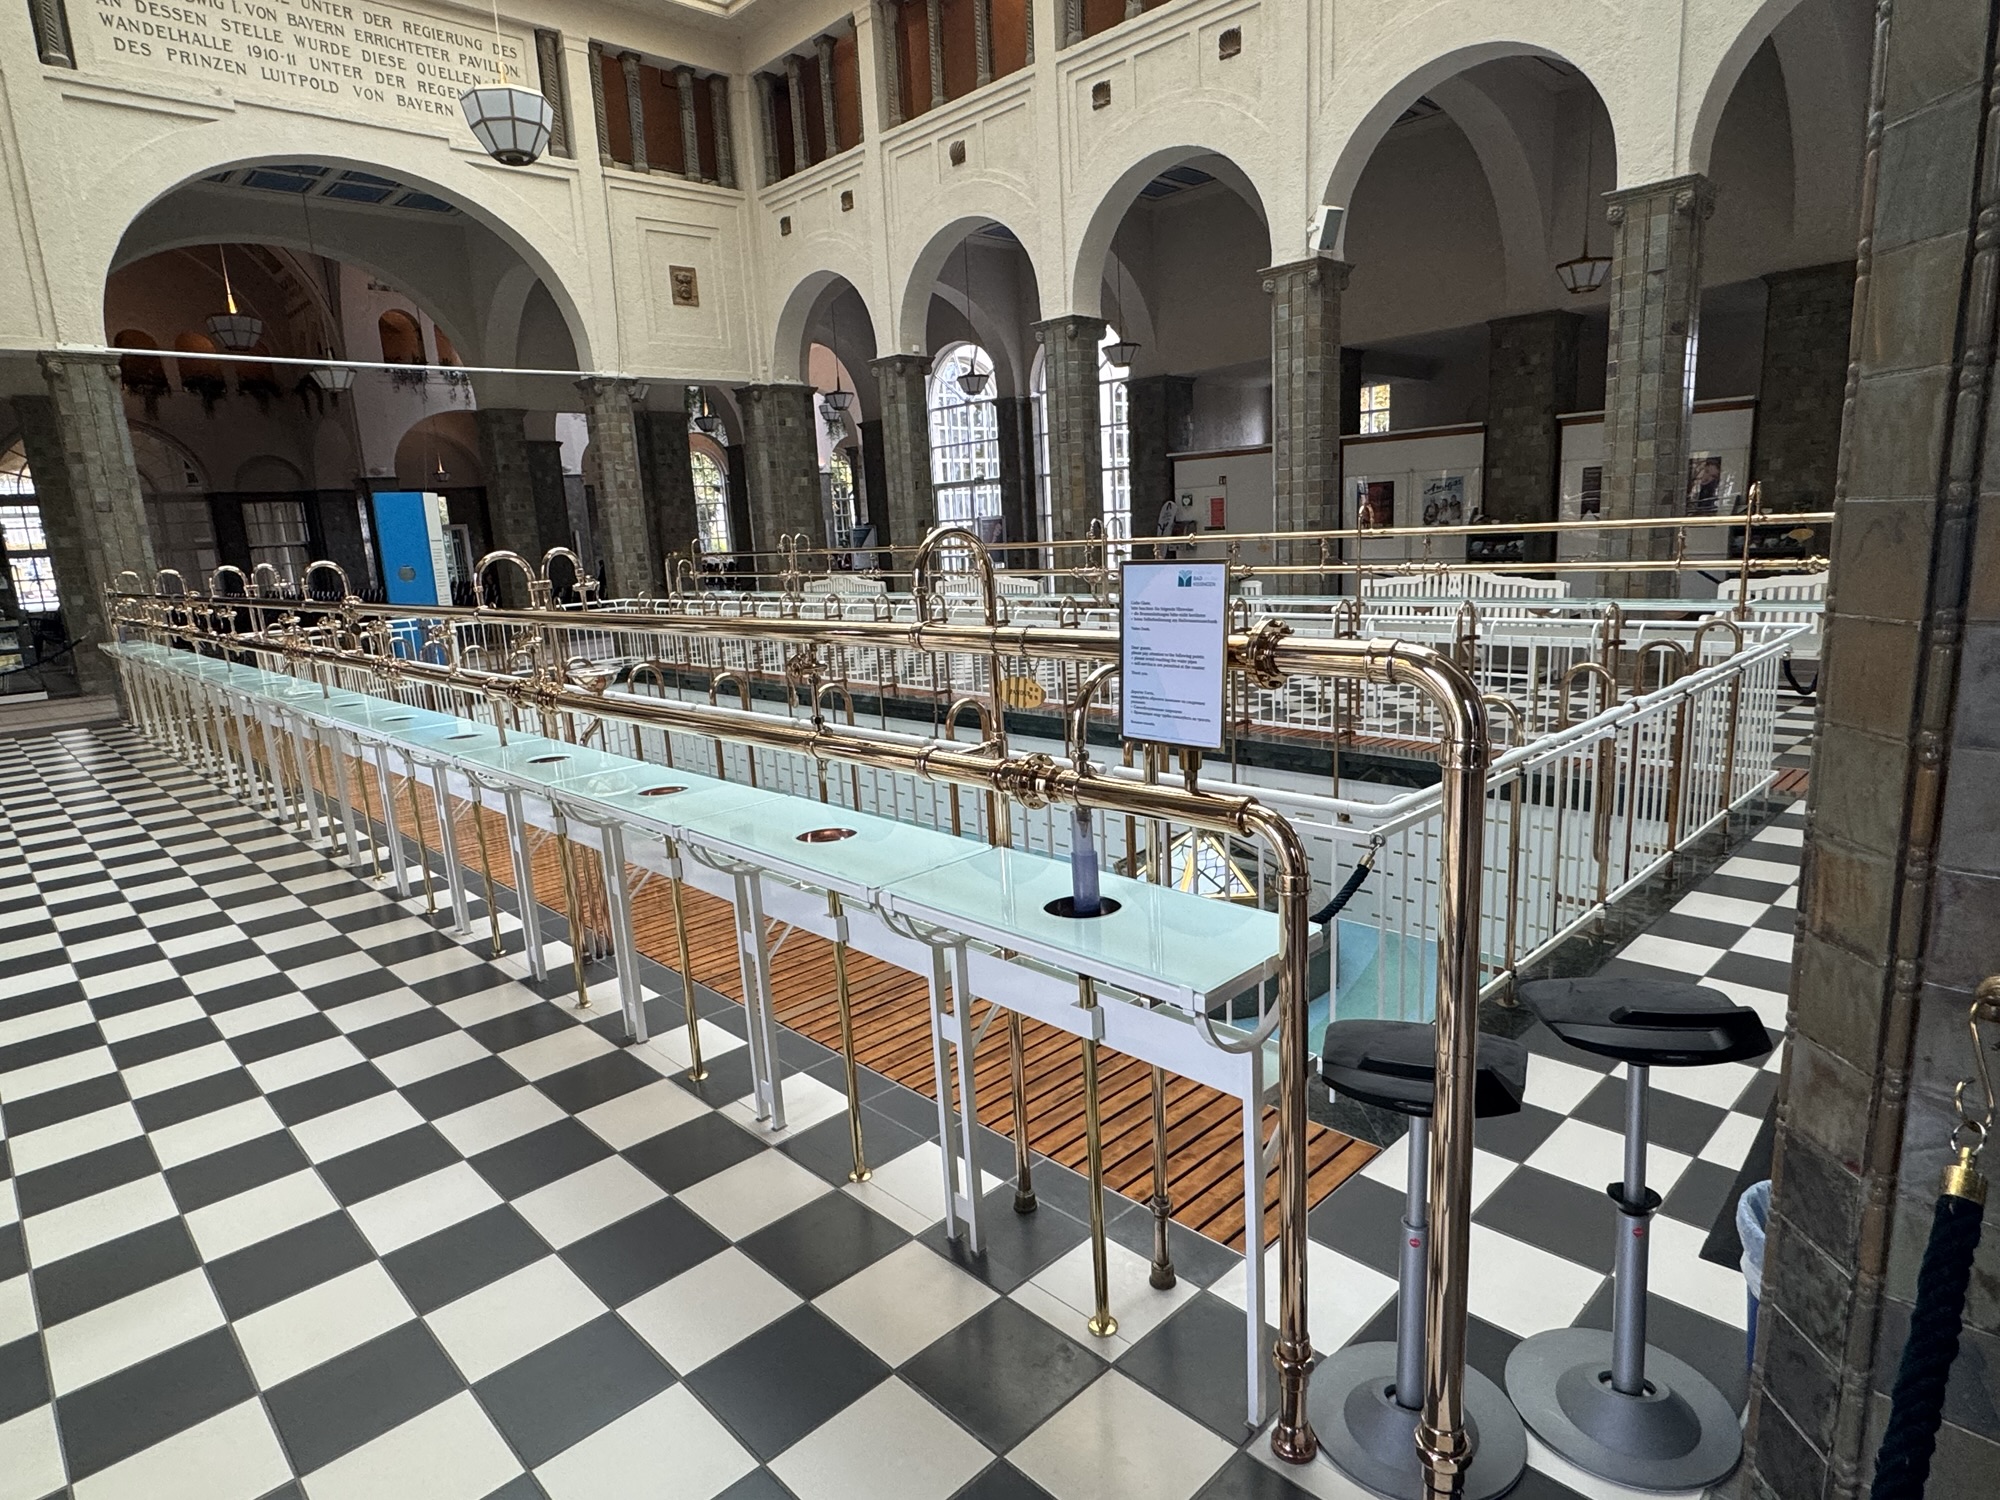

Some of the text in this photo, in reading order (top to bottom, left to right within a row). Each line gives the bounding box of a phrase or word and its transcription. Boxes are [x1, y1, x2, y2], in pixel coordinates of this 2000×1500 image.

[98, 11, 234, 53] WANDELHALLE
[309, 56, 363, 80] UNTER
[375, 71, 406, 88] DER
[134, 0, 207, 27] DESSEN
[220, 18, 284, 44] STELLE
[293, 33, 351, 58] WURDE
[361, 49, 407, 70] DIESE
[244, 2, 277, 22] VON
[286, 12, 345, 37] BAYERN
[354, 28, 451, 62] ERRICHTETER
[301, 0, 518, 59] UNTER DER REGIERUNG DES
[113, 36, 455, 117] DES PRINZEN LUITPOLD VON BAYERN
